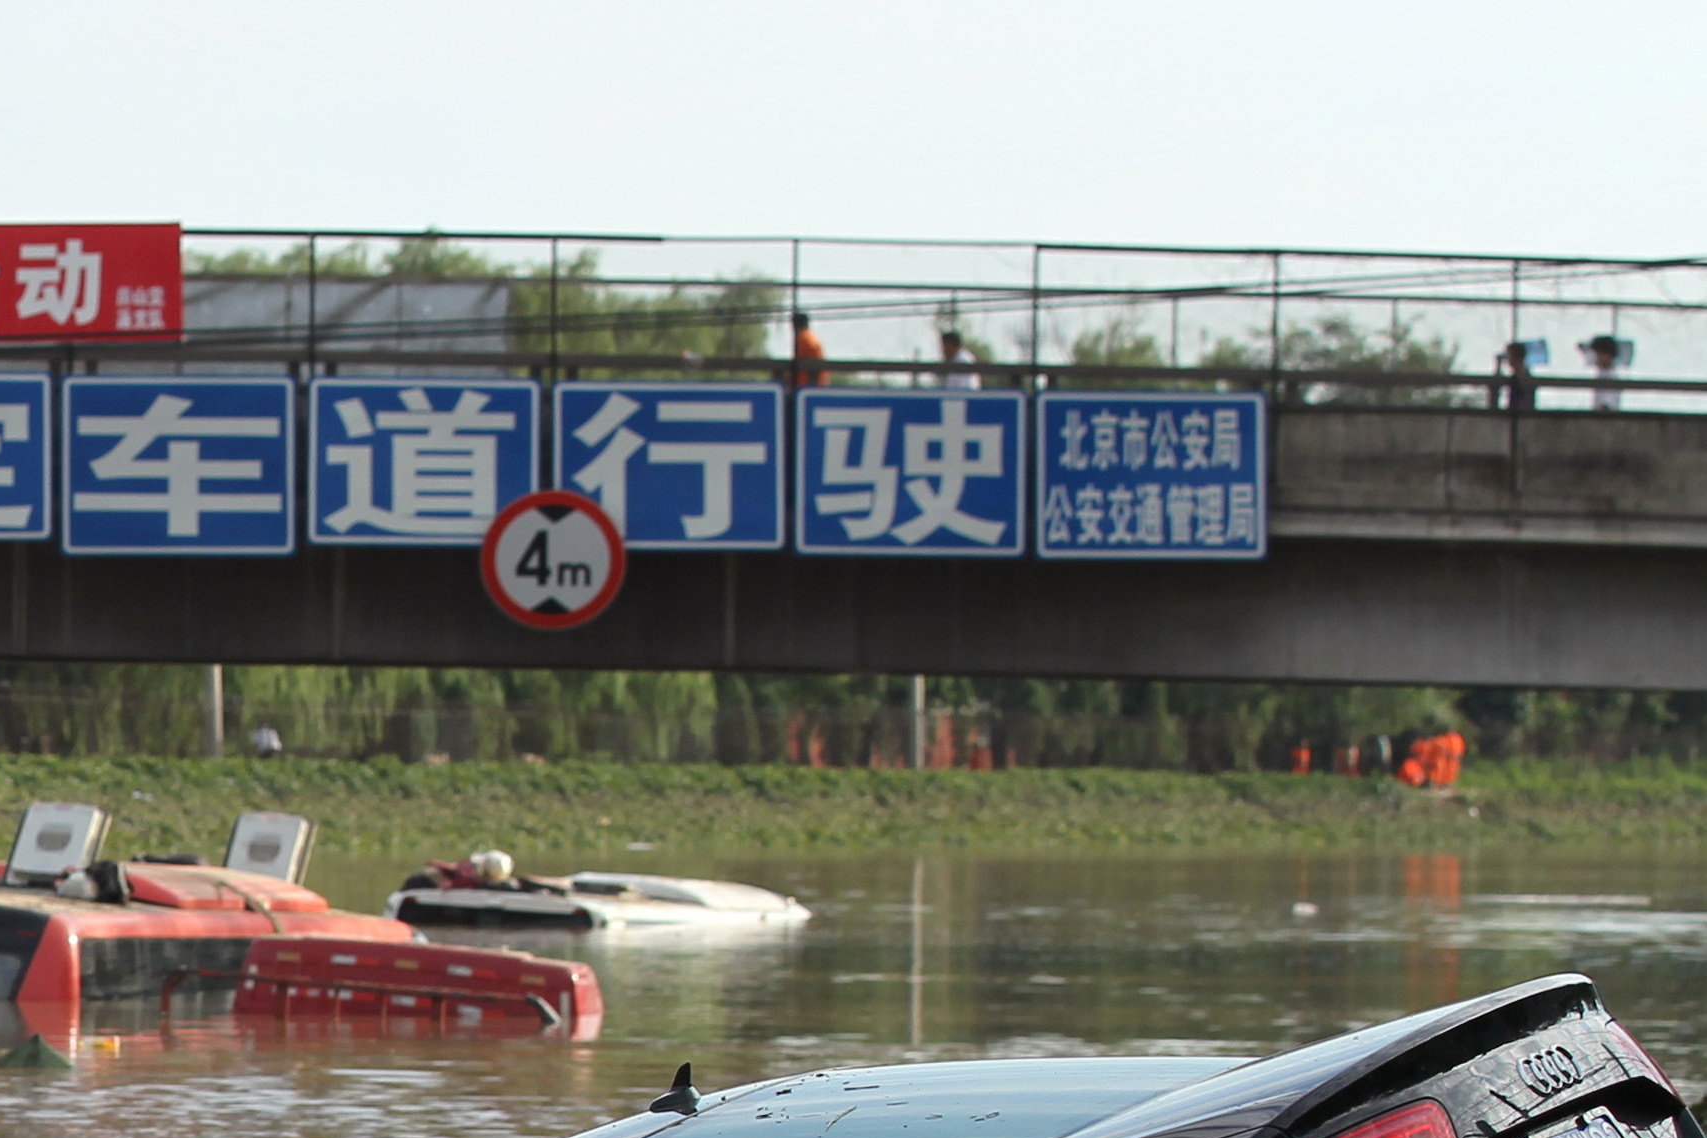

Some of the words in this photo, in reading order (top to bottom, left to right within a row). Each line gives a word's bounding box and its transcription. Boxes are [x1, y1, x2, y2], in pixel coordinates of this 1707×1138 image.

[1060, 408, 1241, 470] 北京市公安局
[1044, 483, 1257, 545] 公安交通管理局
[515, 529, 592, 587] 4m
